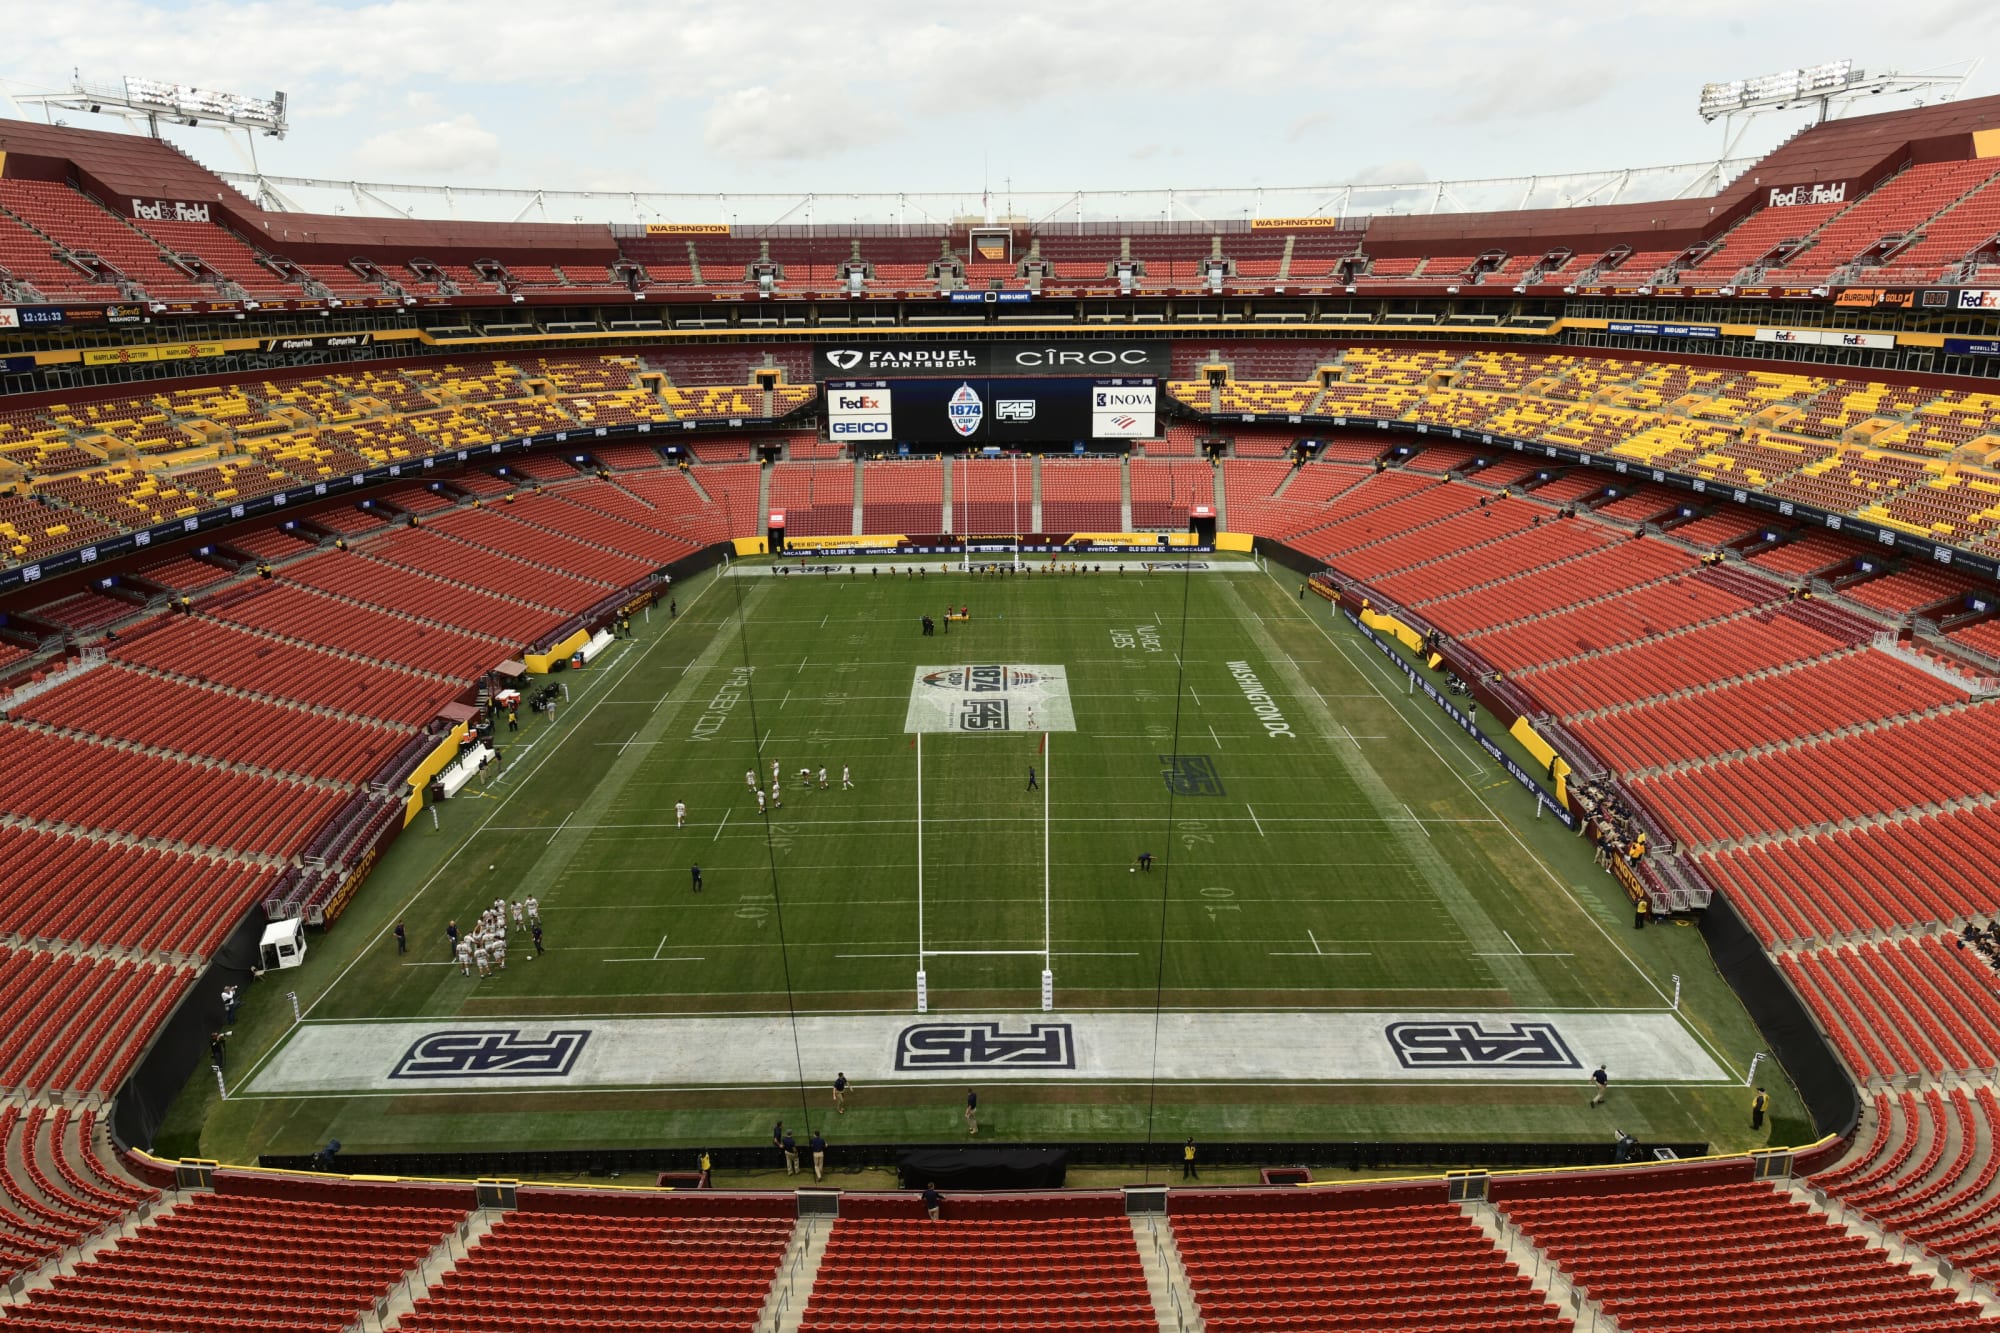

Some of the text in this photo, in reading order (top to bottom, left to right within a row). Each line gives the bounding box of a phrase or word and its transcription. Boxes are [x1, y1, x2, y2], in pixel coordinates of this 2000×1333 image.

[650, 224, 727, 233] WASHINGTON
[1255, 218, 1332, 228] WASHINGTON
[1960, 291, 1997, 307] FedEx
[23, 312, 62, 323] 12:21:33
[1776, 331, 1796, 341] FedEx
[1843, 335, 1866, 345] FedEx
[870, 350, 976, 361] FANDUEL
[1015, 349, 1148, 366] CÎROC
[870, 360, 977, 368] SPORTSBOOK
[840, 396, 879, 409] FedEx
[1111, 394, 1152, 405] INOVA
[950, 405, 981, 415] 1874
[996, 400, 1036, 420] F45
[833, 422, 888, 433] GEICO
[972, 665, 1001, 693] 1874
[1225, 660, 1297, 738] WASHINGTON DC
[324, 847, 376, 918] WASHINGTON
